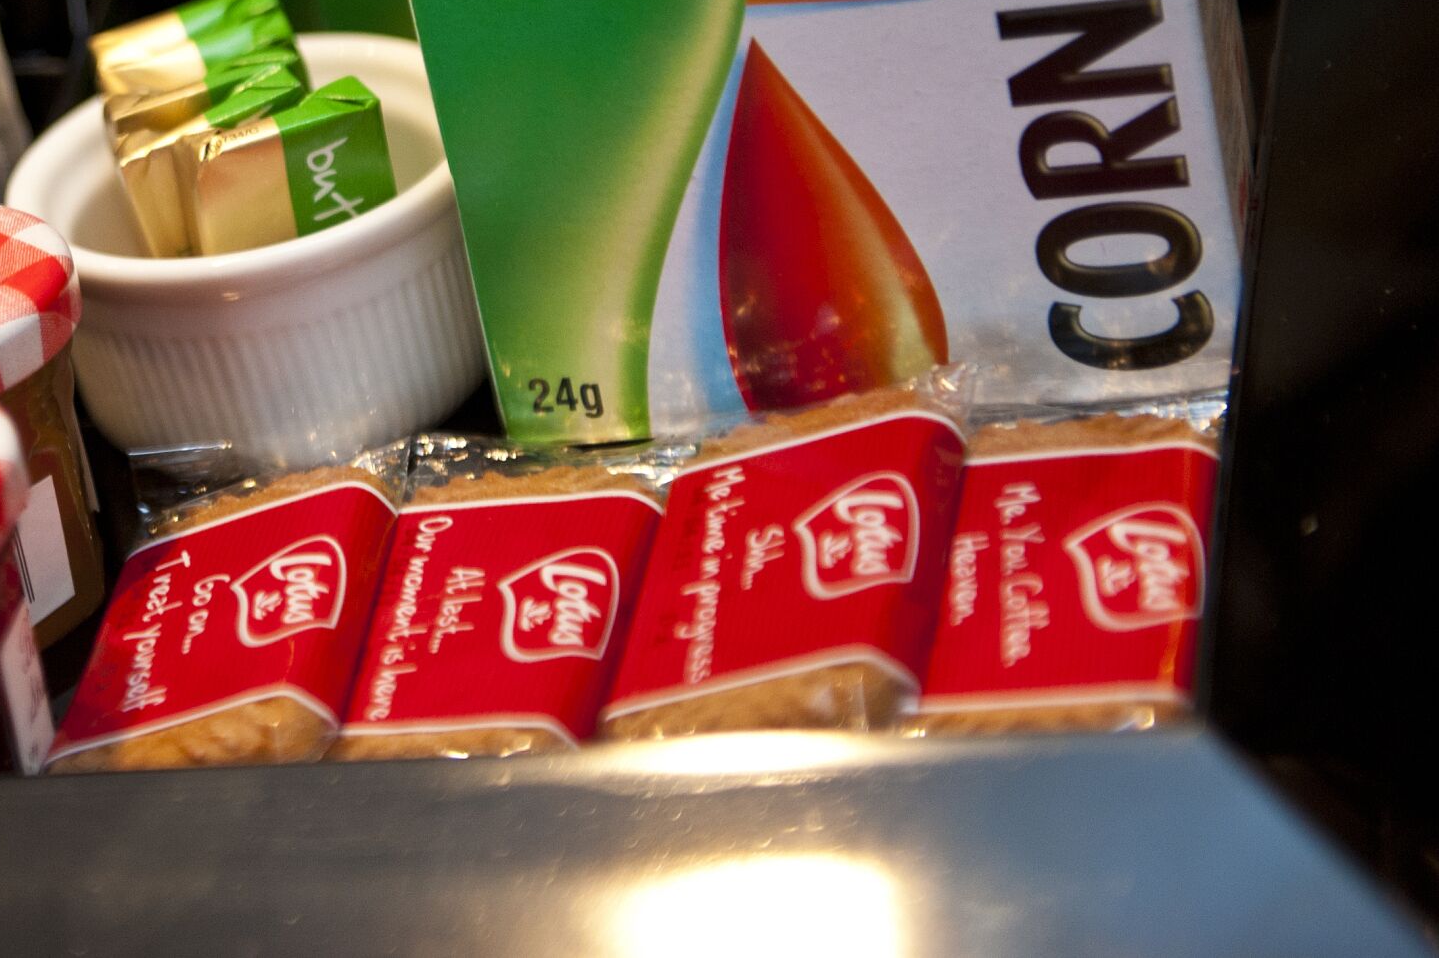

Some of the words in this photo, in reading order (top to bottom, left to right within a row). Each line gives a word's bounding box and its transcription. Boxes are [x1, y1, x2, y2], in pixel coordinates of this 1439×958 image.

[527, 376, 605, 419] 24g
[704, 465, 747, 502] Me
[414, 515, 454, 553] Our
[701, 498, 747, 555] time
[834, 492, 904, 576] Lotus
[141, 549, 192, 623] Treat
[192, 573, 231, 607] Go
[269, 553, 332, 625] Lotus
[446, 565, 486, 596] At
[699, 550, 734, 581] in
[1108, 520, 1191, 613] Lotus
[385, 554, 430, 644] moment
[540, 563, 608, 647] Lotus
[380, 641, 417, 666] is
[672, 579, 722, 686] progress
[120, 622, 169, 714] yourself
[365, 663, 419, 723] here
